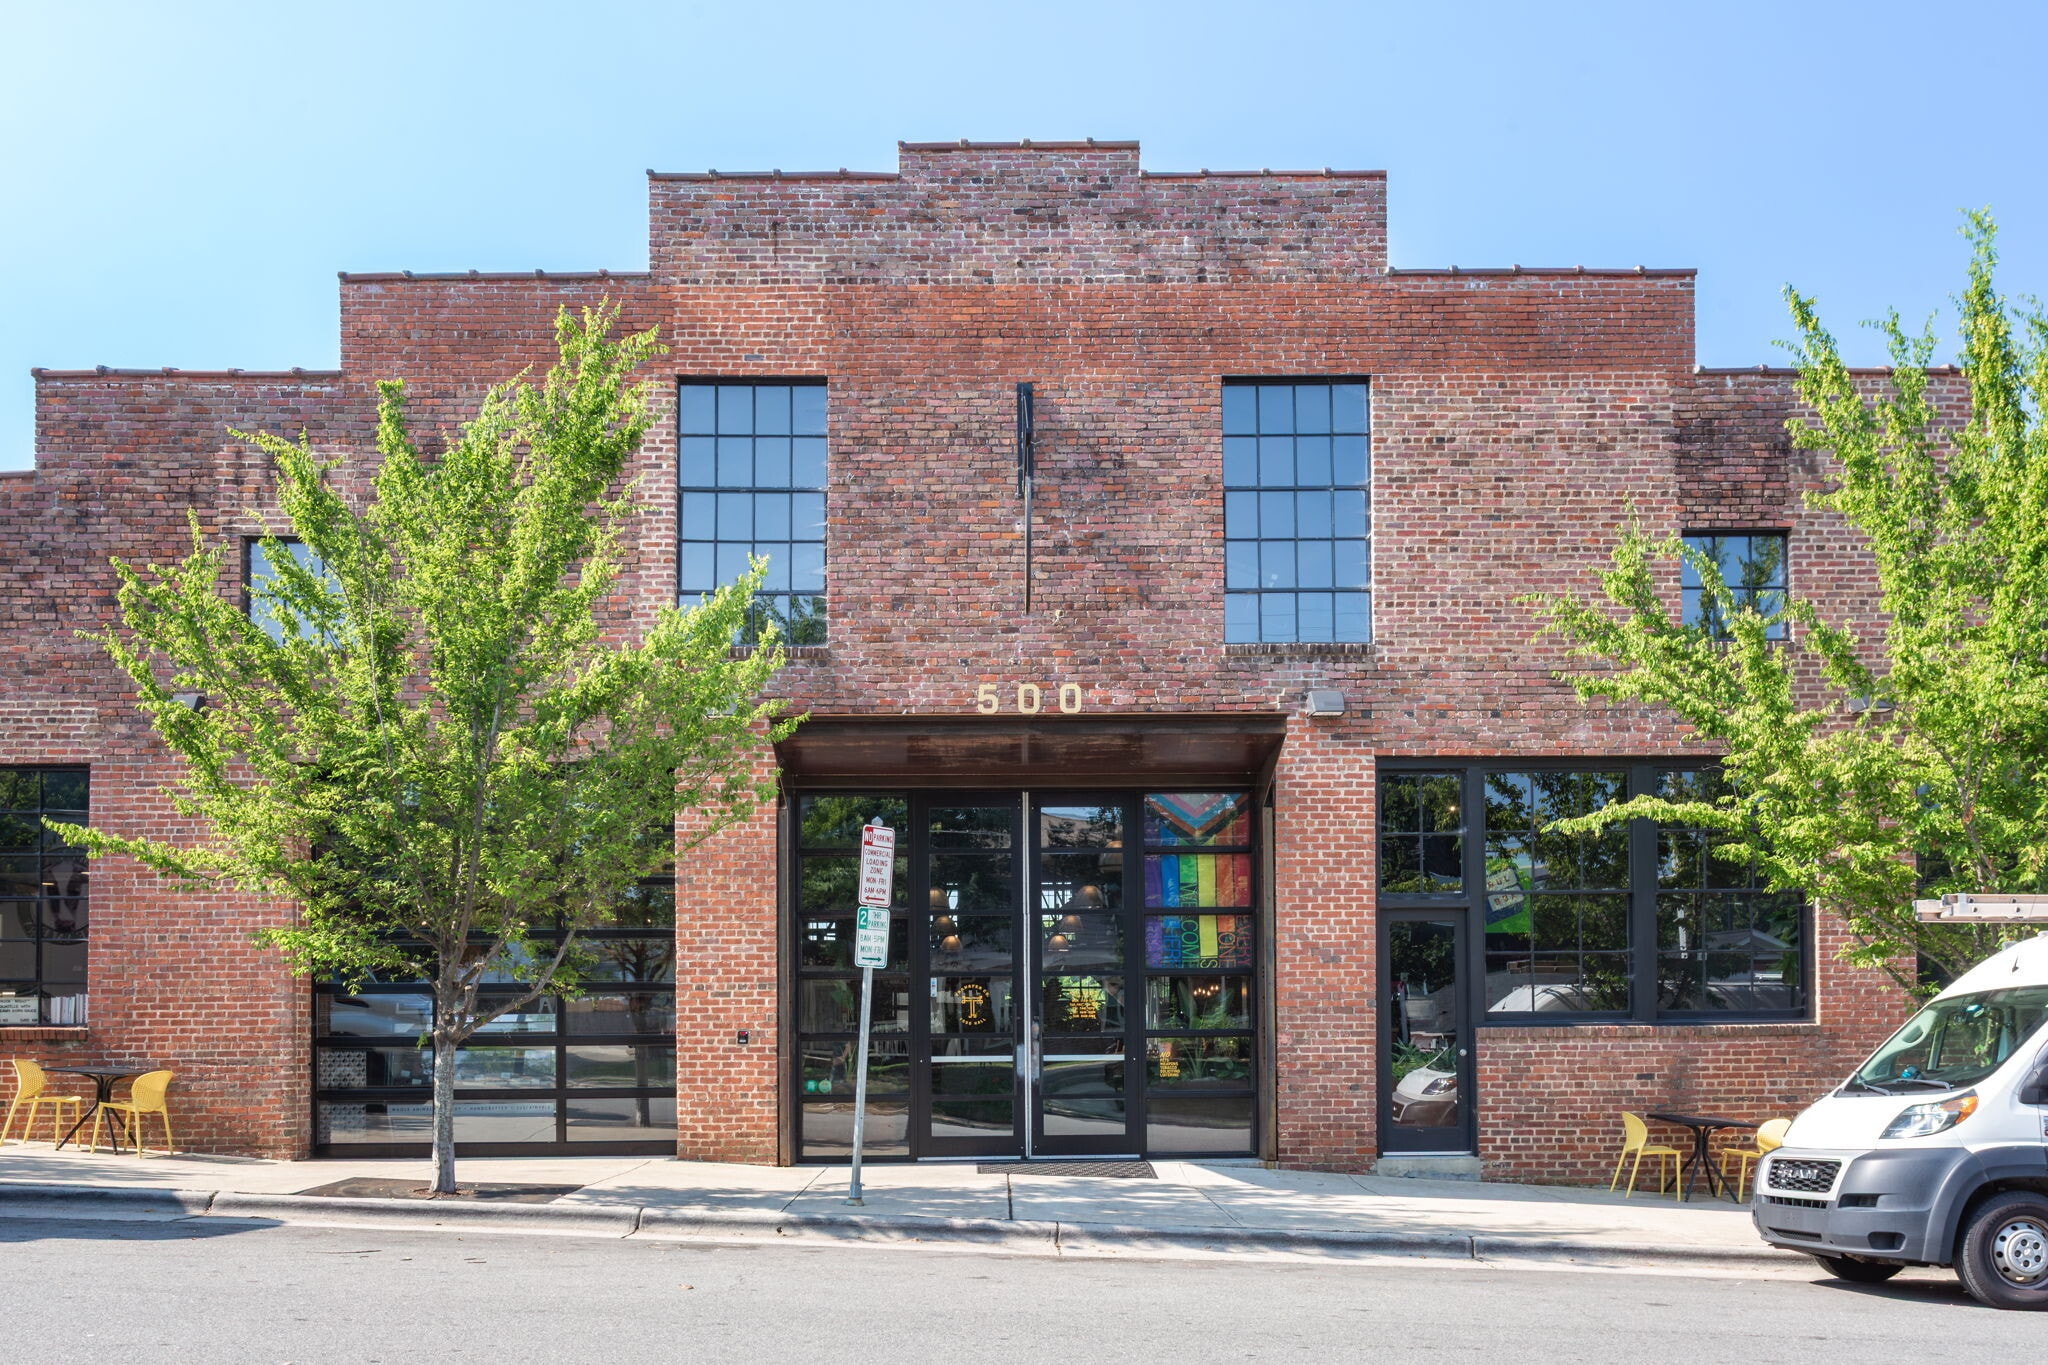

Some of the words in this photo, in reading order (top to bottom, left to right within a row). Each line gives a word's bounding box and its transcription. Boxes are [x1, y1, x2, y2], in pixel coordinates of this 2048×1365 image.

[977, 683, 1082, 715] 500
[864, 831, 873, 842] NO
[873, 833, 894, 844] PARKING
[865, 848, 891, 858] COMMERCIAL
[866, 858, 888, 867] LOADING
[870, 866, 884, 875] ZONE
[860, 911, 867, 925] 2
[868, 920, 887, 929] PARKING
[1236, 915, 1253, 966] EVERY
[1218, 933, 1237, 968] ONE
[1200, 956, 1218, 968] IS
[1782, 1168, 1818, 1179] RAM
